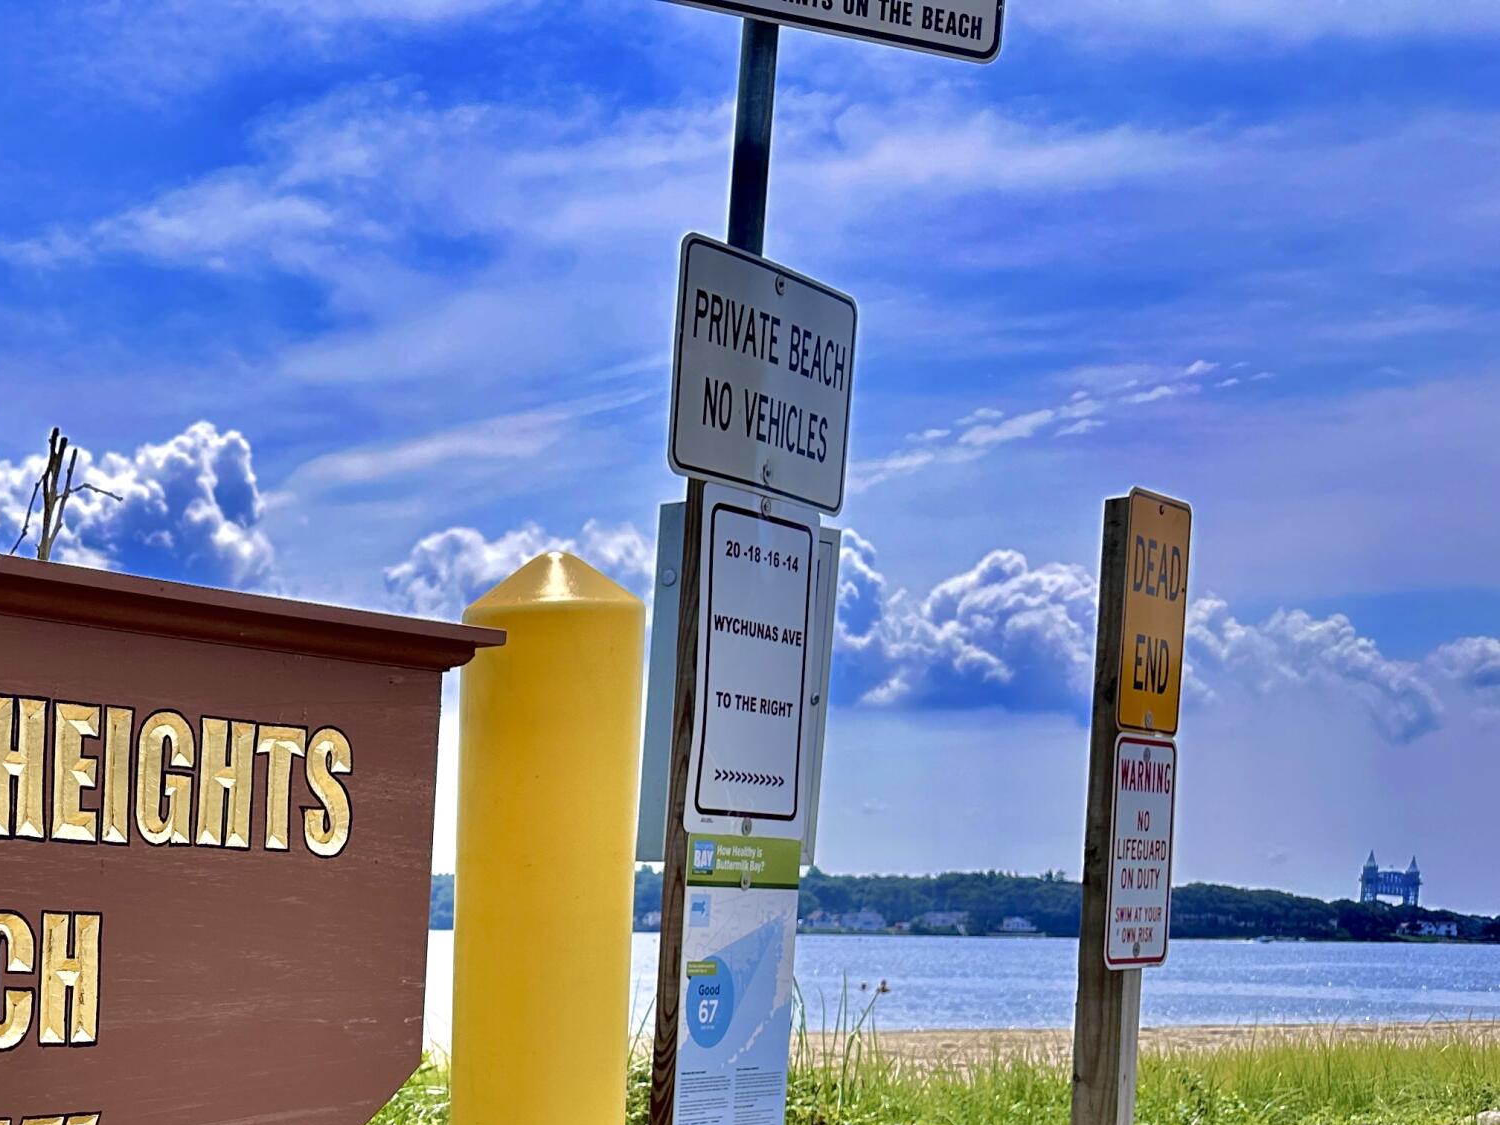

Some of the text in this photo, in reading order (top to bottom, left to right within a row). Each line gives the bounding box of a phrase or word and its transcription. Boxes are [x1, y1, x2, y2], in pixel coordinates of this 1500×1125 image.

[843, 0, 868, 18] ON
[878, 0, 912, 26] THE
[921, 6, 983, 41] BEACH
[693, 288, 846, 392] PRIVATE BEACH
[702, 376, 828, 463] NO VEHICLES
[725, 540, 741, 558] 20
[1132, 534, 1182, 602] DEAD
[713, 613, 802, 647] WYCHUNAS AVE
[1132, 633, 1170, 695] END
[715, 691, 793, 718] TO THE RIGHT
[1120, 758, 1172, 795] WARNING
[1137, 810, 1150, 833] NO
[693, 849, 714, 868] BAY
[1116, 838, 1167, 861] LIFEGUARD
[1120, 867, 1161, 890] ON DUTY
[1115, 906, 1162, 923] SWIM AT YOUR
[1121, 926, 1154, 943] OWN RISK
[698, 983, 721, 996] Good
[698, 999, 719, 1024] 67
